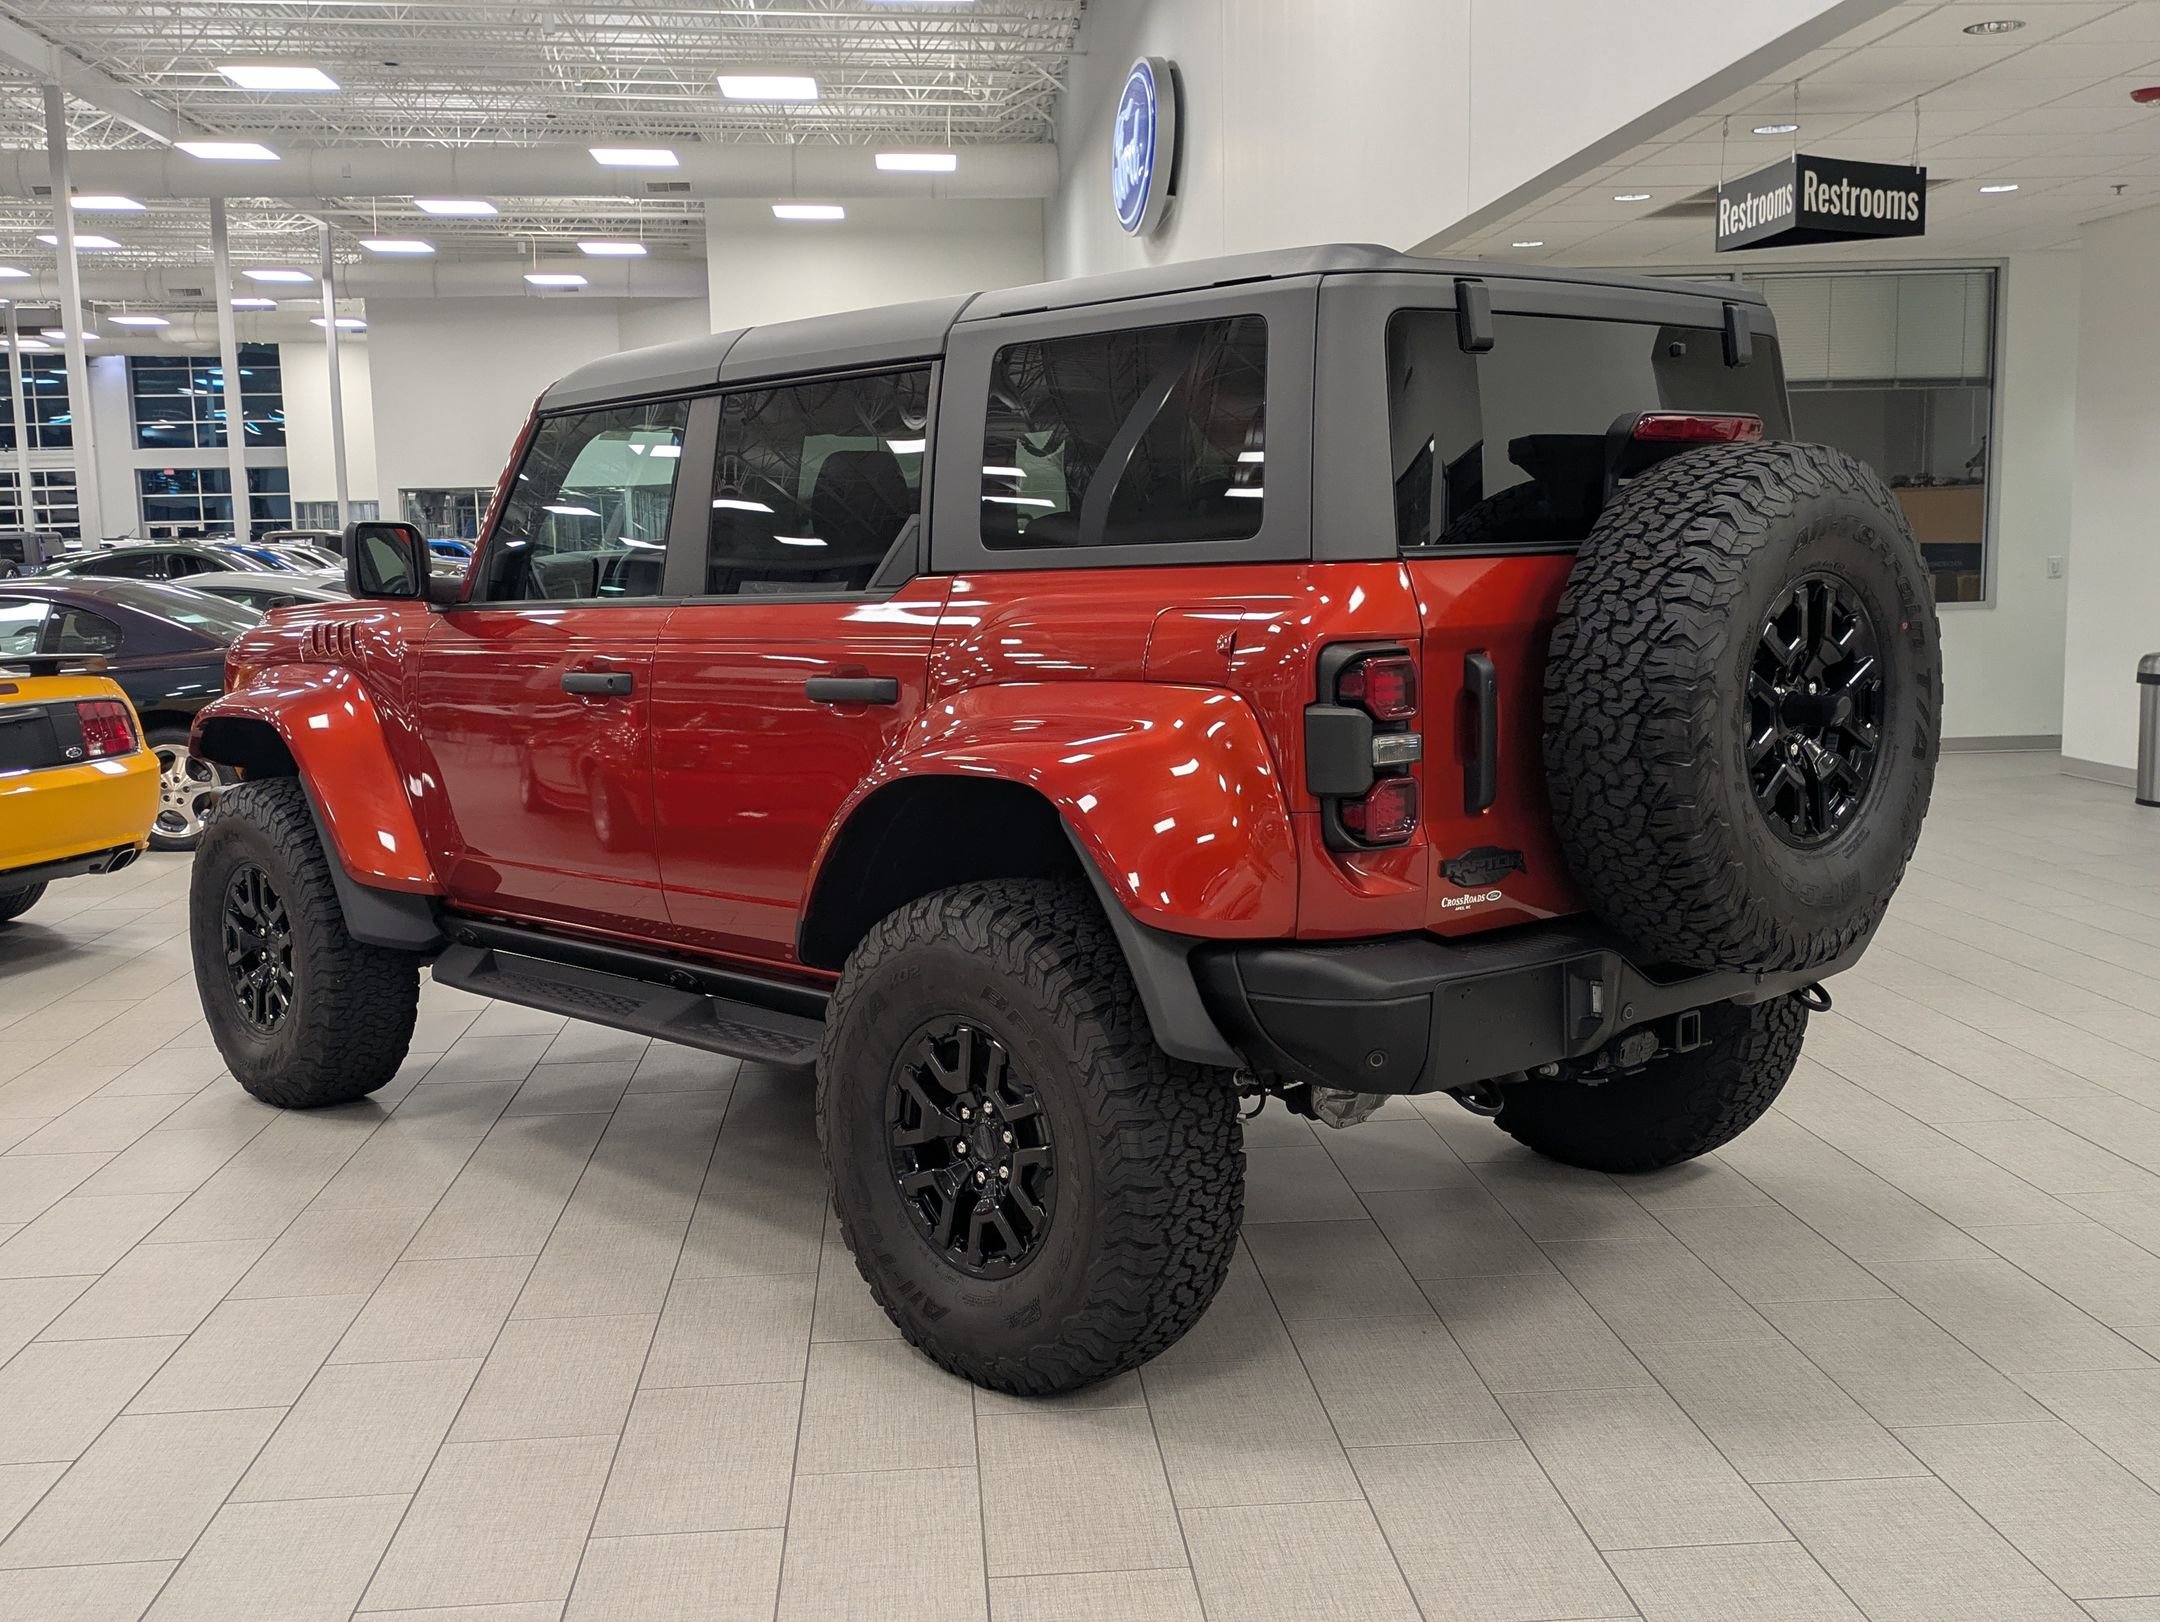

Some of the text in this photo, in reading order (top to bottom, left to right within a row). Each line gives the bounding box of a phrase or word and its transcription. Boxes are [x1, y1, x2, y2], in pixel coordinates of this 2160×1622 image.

[1719, 183, 1793, 238] Restrooms
[1803, 170, 1919, 221] Restrooms
[1439, 850, 1527, 884] RAPTOR
